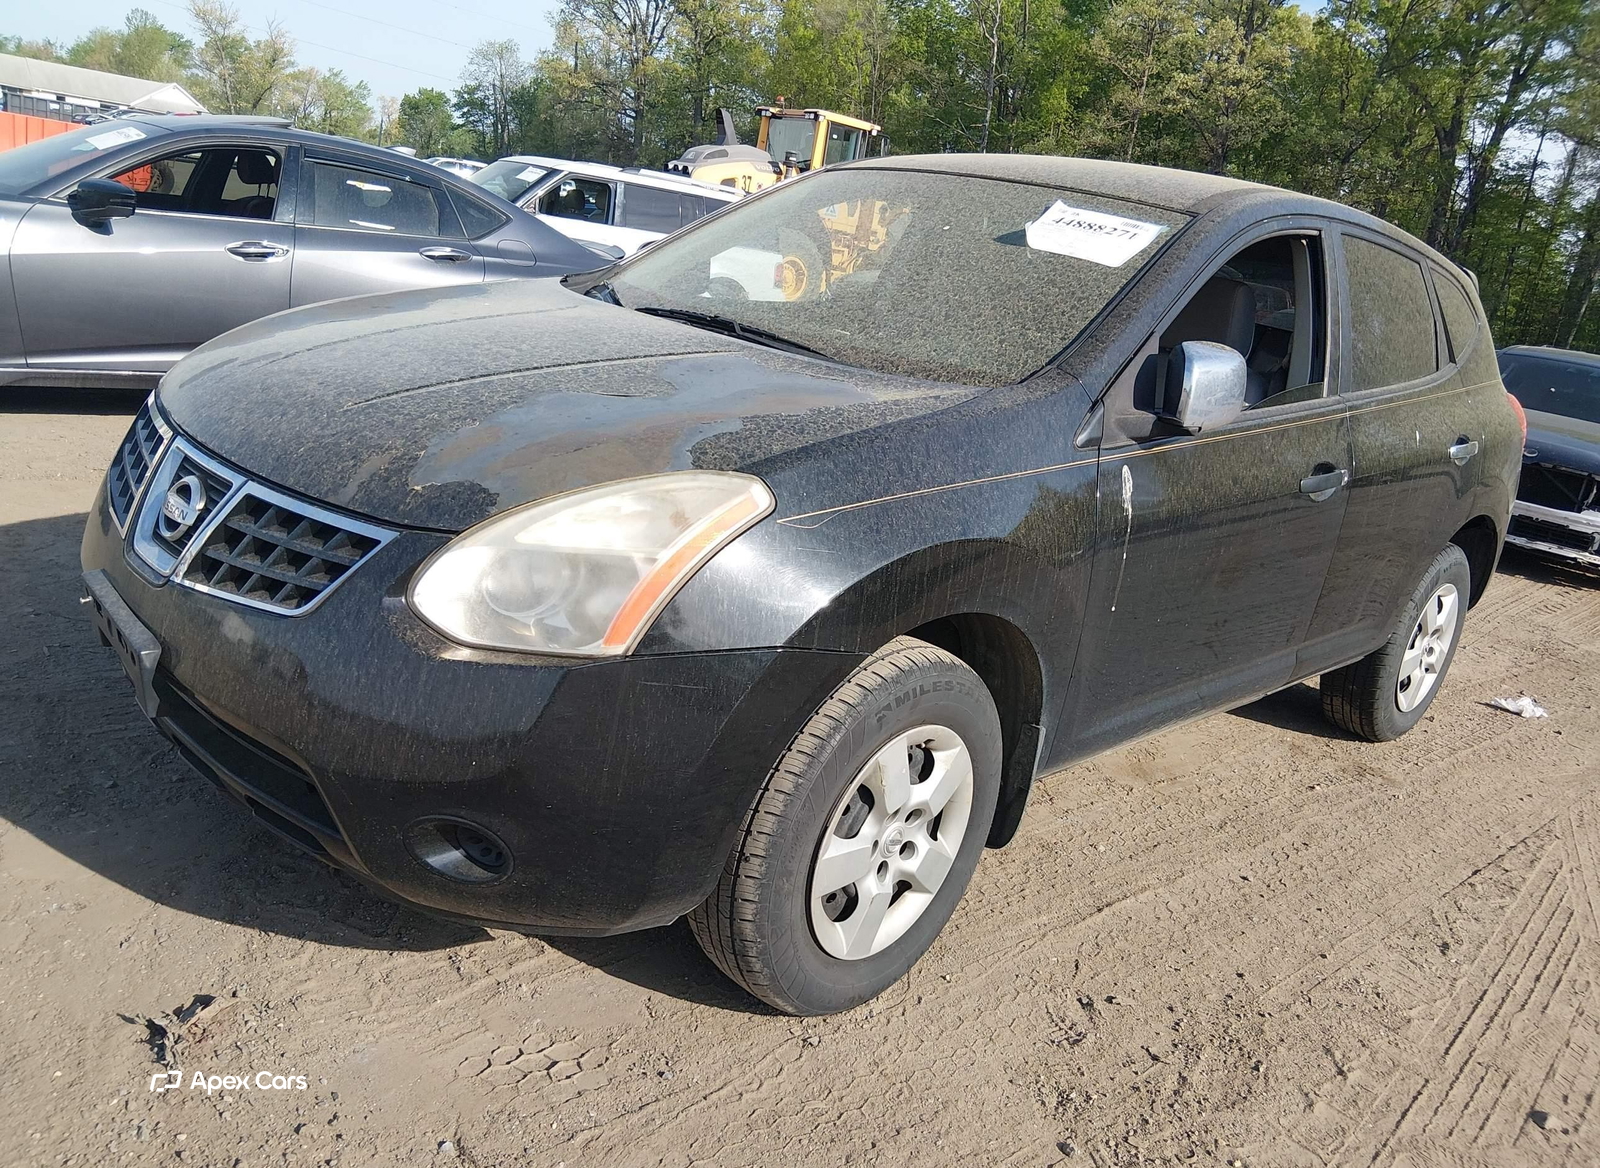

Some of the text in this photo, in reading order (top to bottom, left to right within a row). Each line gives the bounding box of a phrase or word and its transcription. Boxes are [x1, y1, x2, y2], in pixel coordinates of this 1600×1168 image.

[741, 175, 752, 192] 37
[1052, 217, 1139, 240] 44888271
[165, 500, 189, 521] SSAN
